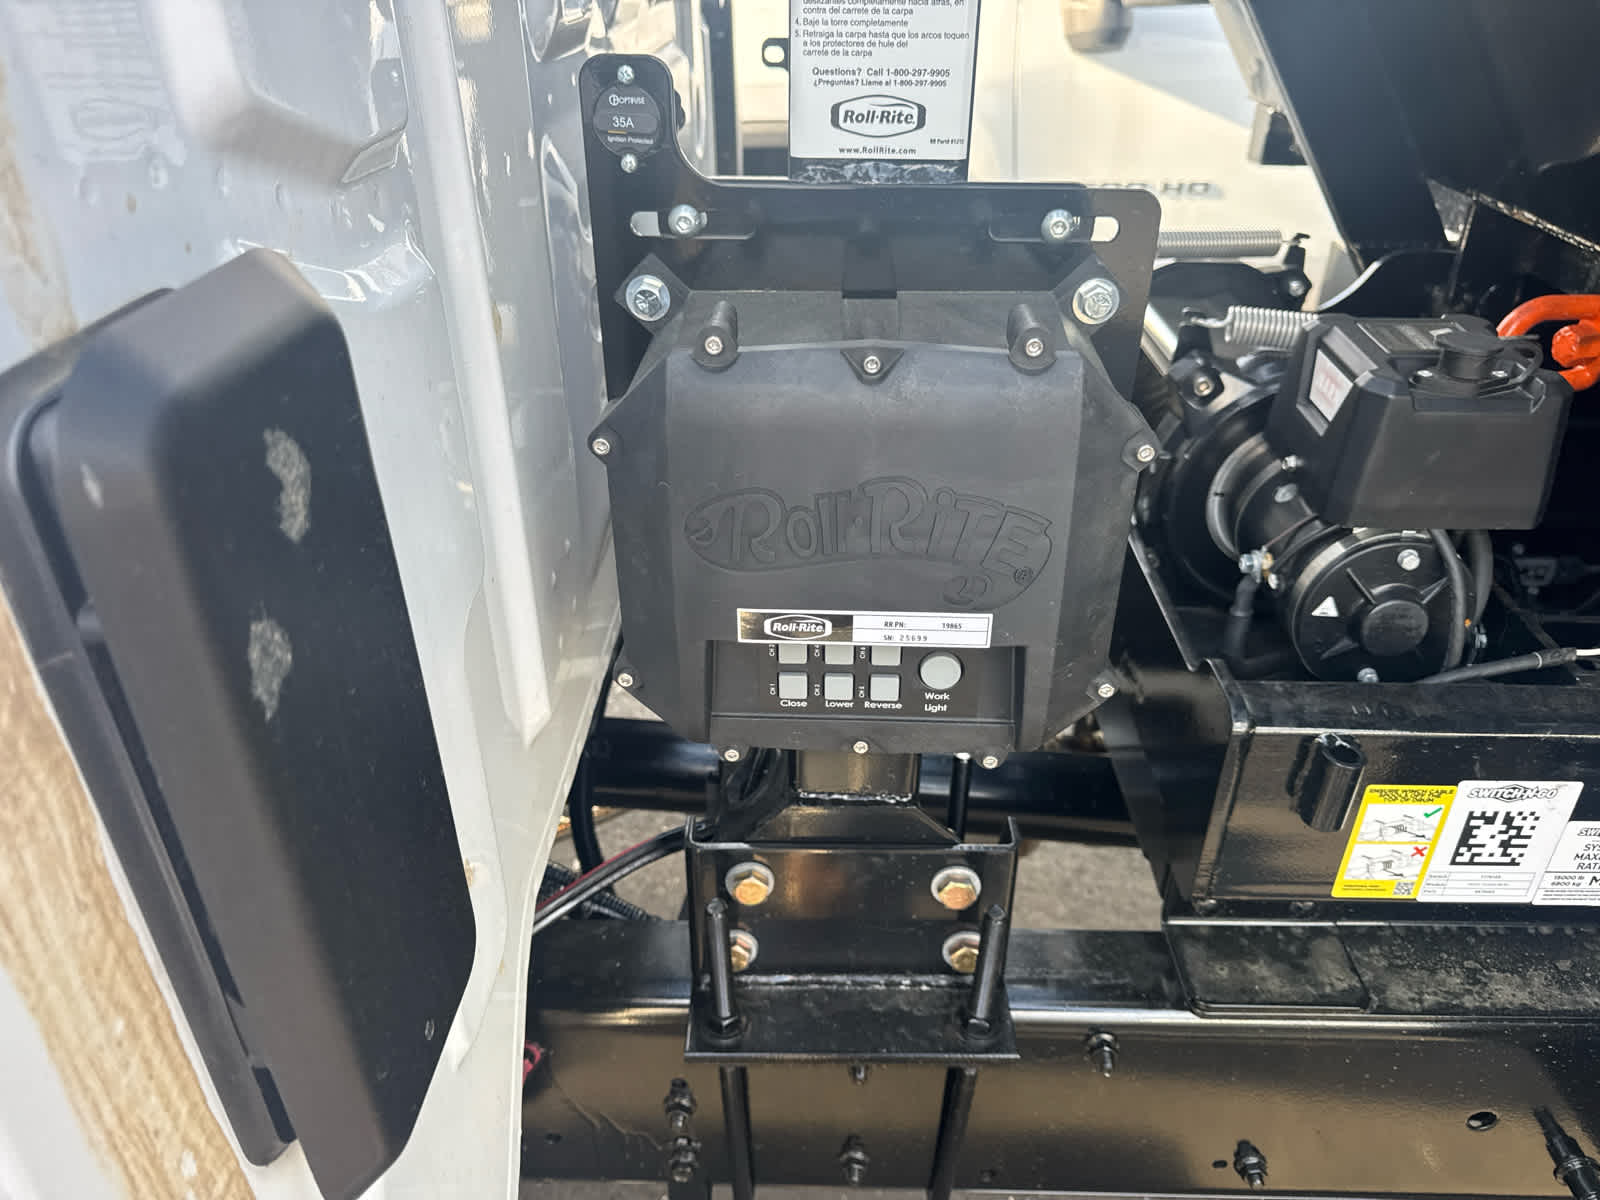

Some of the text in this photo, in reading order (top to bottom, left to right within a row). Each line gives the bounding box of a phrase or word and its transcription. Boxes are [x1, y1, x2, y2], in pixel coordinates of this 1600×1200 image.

[828, 6, 840, 14] del
[891, 8, 914, 16] carpa
[802, 18, 820, 27] Baje
[850, 18, 908, 27] completamente
[802, 30, 834, 39] Retraiga
[836, 30, 843, 38] la
[845, 31, 866, 39] carpa
[868, 30, 890, 38] hasta
[892, 32, 906, 40] que
[908, 30, 919, 38] los
[944, 32, 970, 40] toquen
[822, 40, 864, 48] protectores
[878, 40, 894, 48] hule
[896, 40, 908, 48] del
[842, 48, 850, 56] la
[851, 50, 872, 58] carpa
[812, 67, 950, 78] Questions? Call 1-800-297-9905
[814, 78, 858, 87] ¿Preguntas?
[894, 80, 947, 88] 1-800-297-9905
[612, 116, 634, 128] 35A
[838, 146, 916, 154] www.RollRite.com
[925, 692, 950, 700] Work
[825, 700, 854, 708] Lower
[864, 702, 902, 710] Reverse
[924, 704, 948, 713] Light
